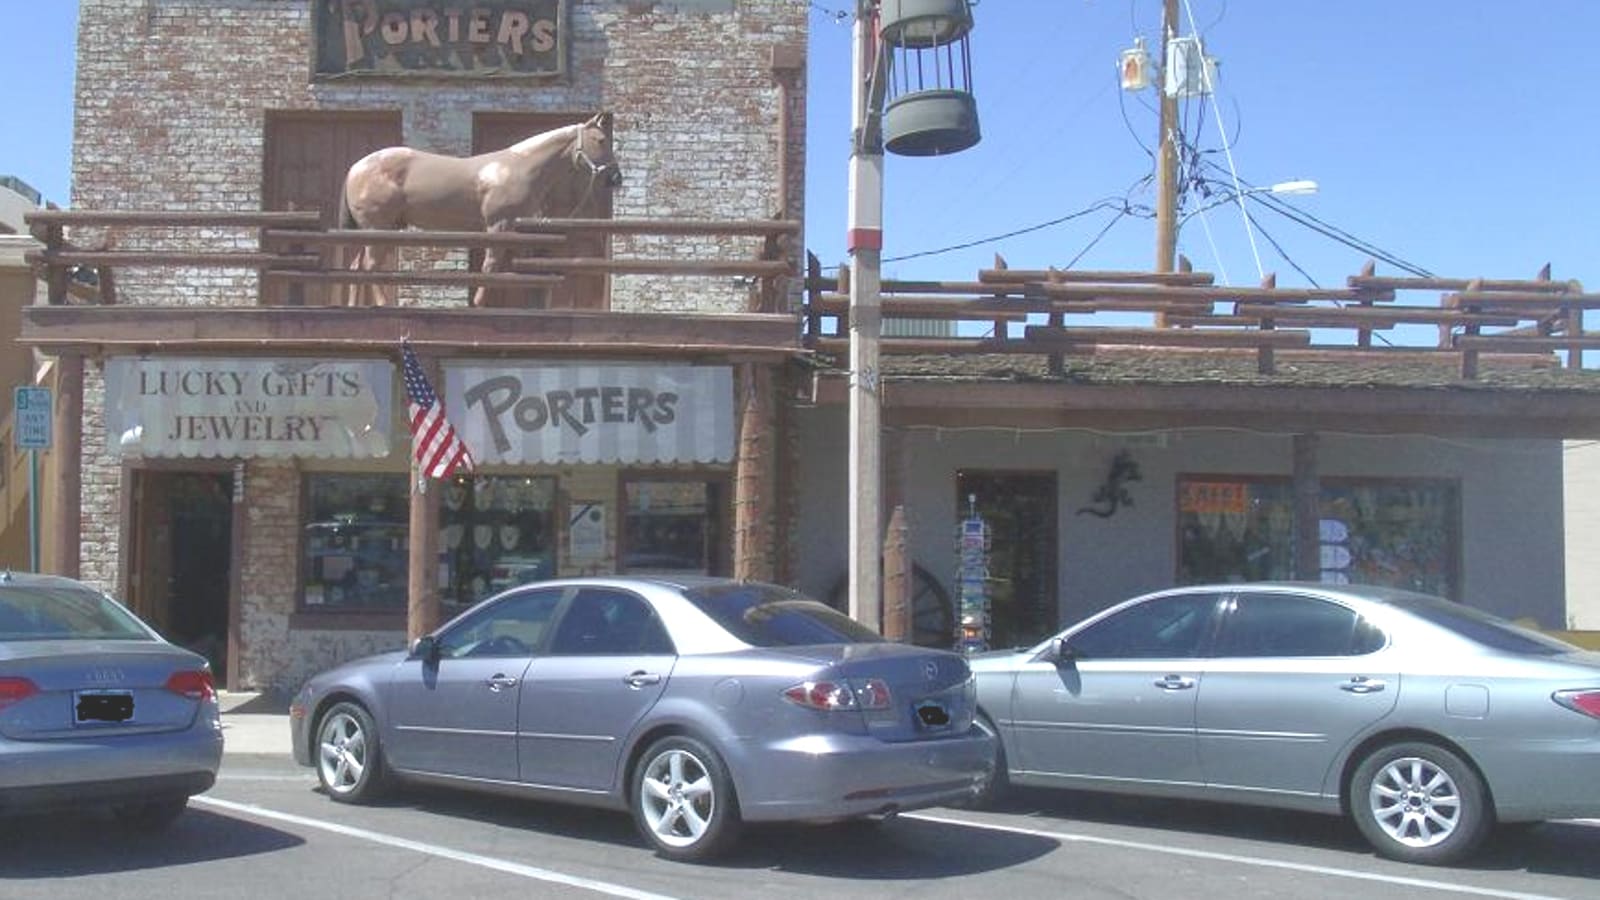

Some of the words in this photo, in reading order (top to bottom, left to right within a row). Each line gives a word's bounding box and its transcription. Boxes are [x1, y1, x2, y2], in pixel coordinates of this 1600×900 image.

[328, 0, 557, 65] PORTERS
[138, 371, 249, 396] LUCKY
[262, 371, 360, 397] GIFTS
[234, 400, 266, 413] AND
[464, 375, 679, 454] PORTERS
[169, 415, 326, 441] JEWELRY
